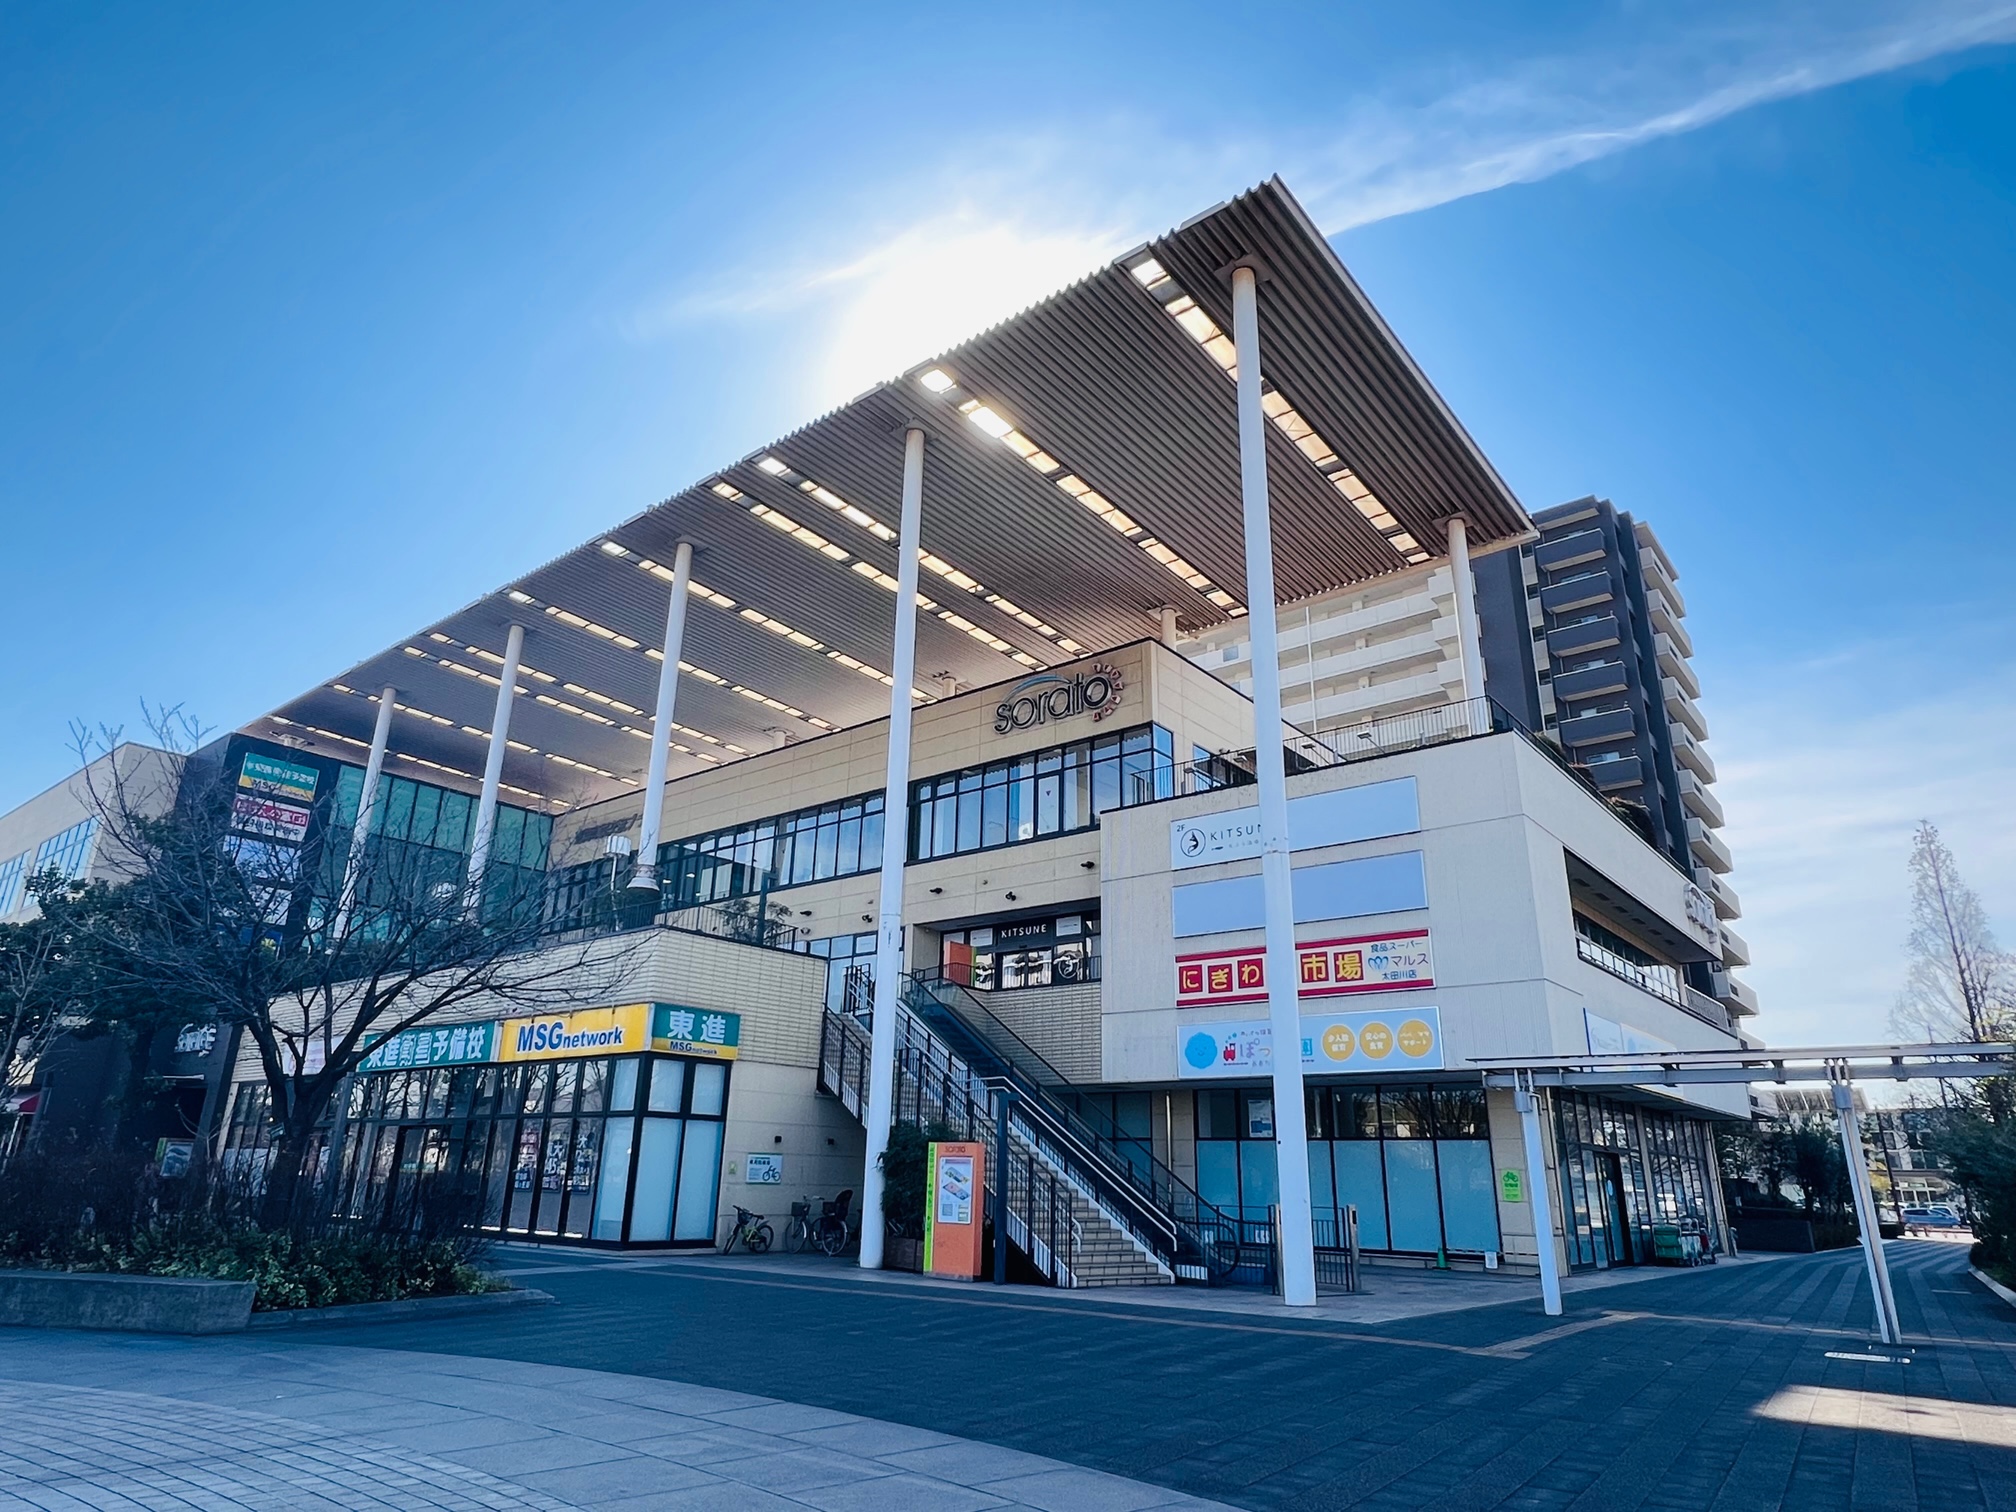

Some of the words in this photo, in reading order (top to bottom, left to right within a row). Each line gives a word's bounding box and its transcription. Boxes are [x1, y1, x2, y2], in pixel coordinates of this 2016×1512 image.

[994, 673, 1112, 734] sorato
[1176, 824, 1186, 832] 2F
[1001, 924, 1047, 938] KITSUNE
[1370, 940, 1423, 953] 食品スーパー
[1391, 953, 1429, 966] マルス
[1381, 970, 1417, 980] 太田川店
[667, 1010, 726, 1044] 東進
